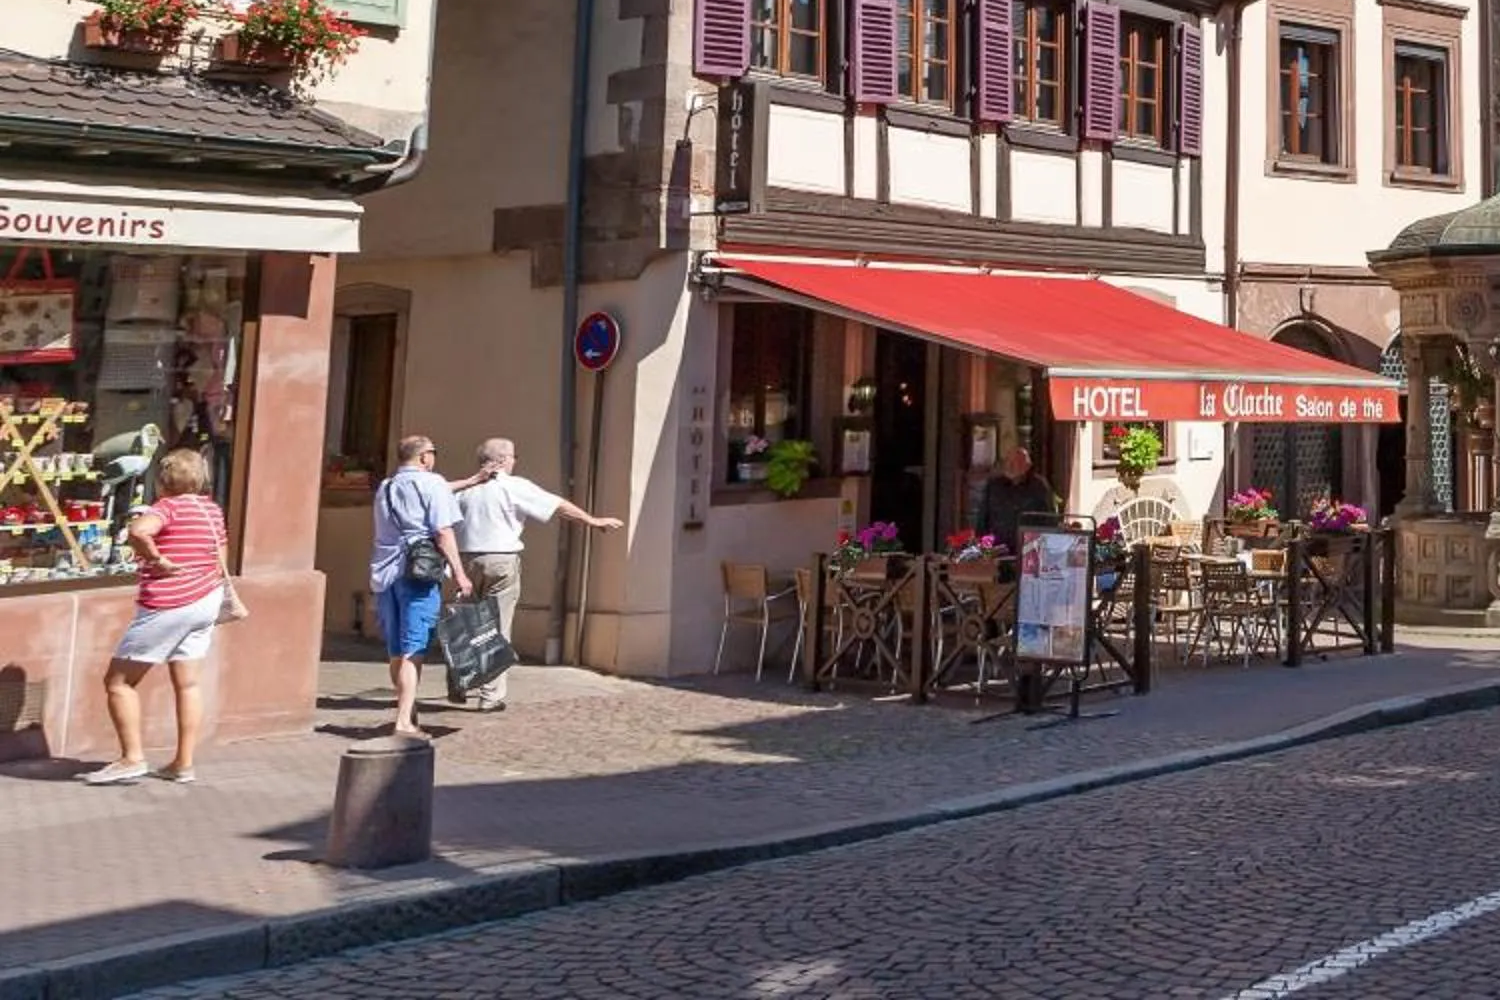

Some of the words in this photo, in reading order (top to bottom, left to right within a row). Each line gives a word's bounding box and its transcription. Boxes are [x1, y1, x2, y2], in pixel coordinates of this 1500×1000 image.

[0, 204, 165, 239] Souvenirs
[1073, 386, 1148, 417] HOTEL
[1200, 385, 1216, 417] la
[1223, 384, 1283, 417] Cloche
[1296, 393, 1333, 417] Salon
[1339, 396, 1356, 418] de
[1362, 398, 1384, 418] thé
